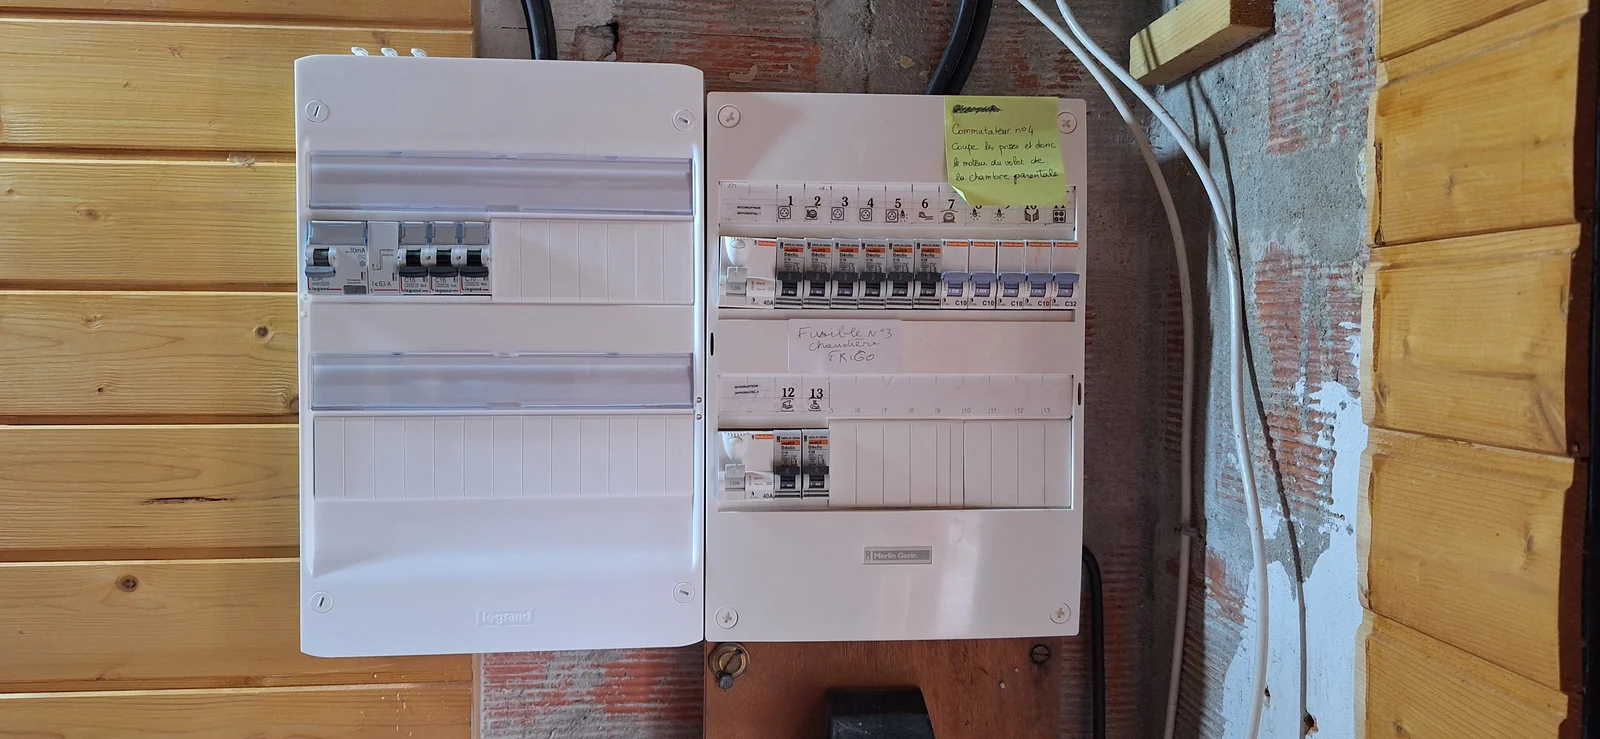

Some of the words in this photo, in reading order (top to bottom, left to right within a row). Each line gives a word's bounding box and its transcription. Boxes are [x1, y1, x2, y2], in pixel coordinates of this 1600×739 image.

[952, 123, 1010, 136] Commutateur
[1024, 141, 1033, 150] et
[1035, 140, 1056, 149] donc
[952, 157, 960, 168] le
[1004, 156, 1024, 166] volet
[969, 172, 1010, 182] chambre
[1014, 168, 1060, 184] parentale
[788, 196, 794, 206] 1
[814, 196, 821, 206] 2
[842, 196, 848, 207] 3
[867, 198, 874, 208] 4
[894, 198, 902, 208] 5
[922, 198, 928, 208] 6
[948, 199, 955, 209] 7
[798, 326, 862, 339] Fusible
[782, 387, 794, 398] 12
[810, 388, 823, 399] 13
[482, 610, 530, 624] legrand
